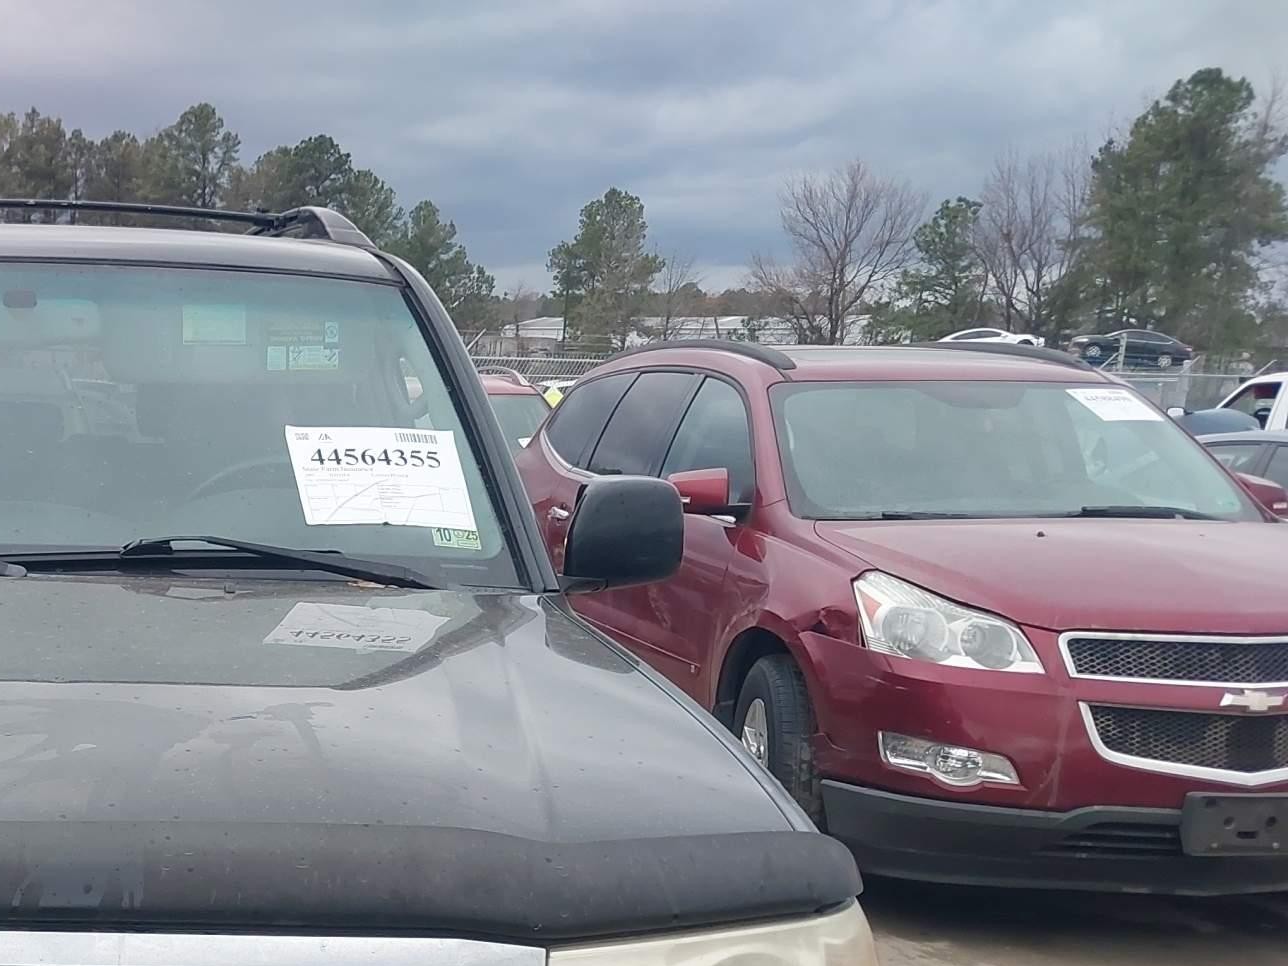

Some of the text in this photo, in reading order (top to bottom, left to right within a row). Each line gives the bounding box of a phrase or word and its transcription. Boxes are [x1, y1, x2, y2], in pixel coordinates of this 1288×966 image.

[310, 448, 441, 469] 44564355
[436, 527, 452, 542] 10
[465, 530, 478, 541] 25
